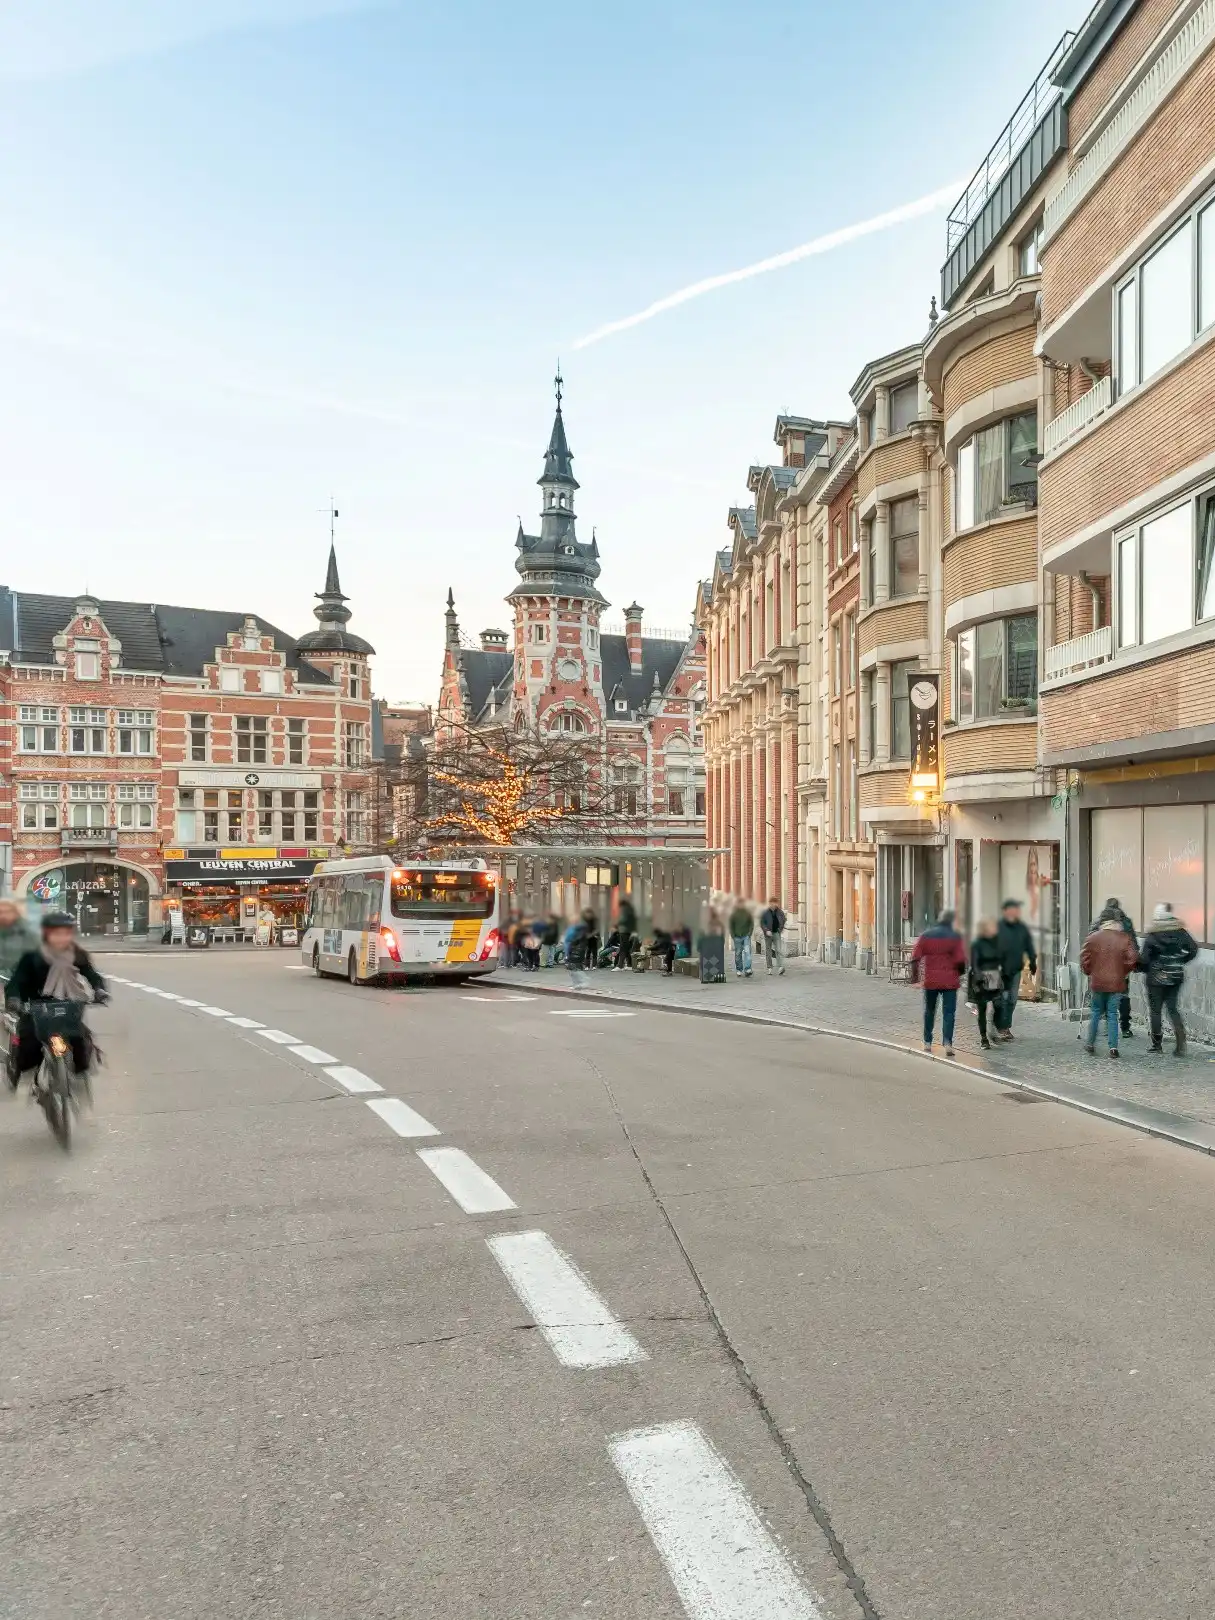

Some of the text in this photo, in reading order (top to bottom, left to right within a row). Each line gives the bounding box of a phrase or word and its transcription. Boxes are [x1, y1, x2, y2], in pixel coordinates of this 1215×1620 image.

[928, 720, 937, 766] ラーメン
[200, 860, 296, 869] LEUVEN CENTRAL
